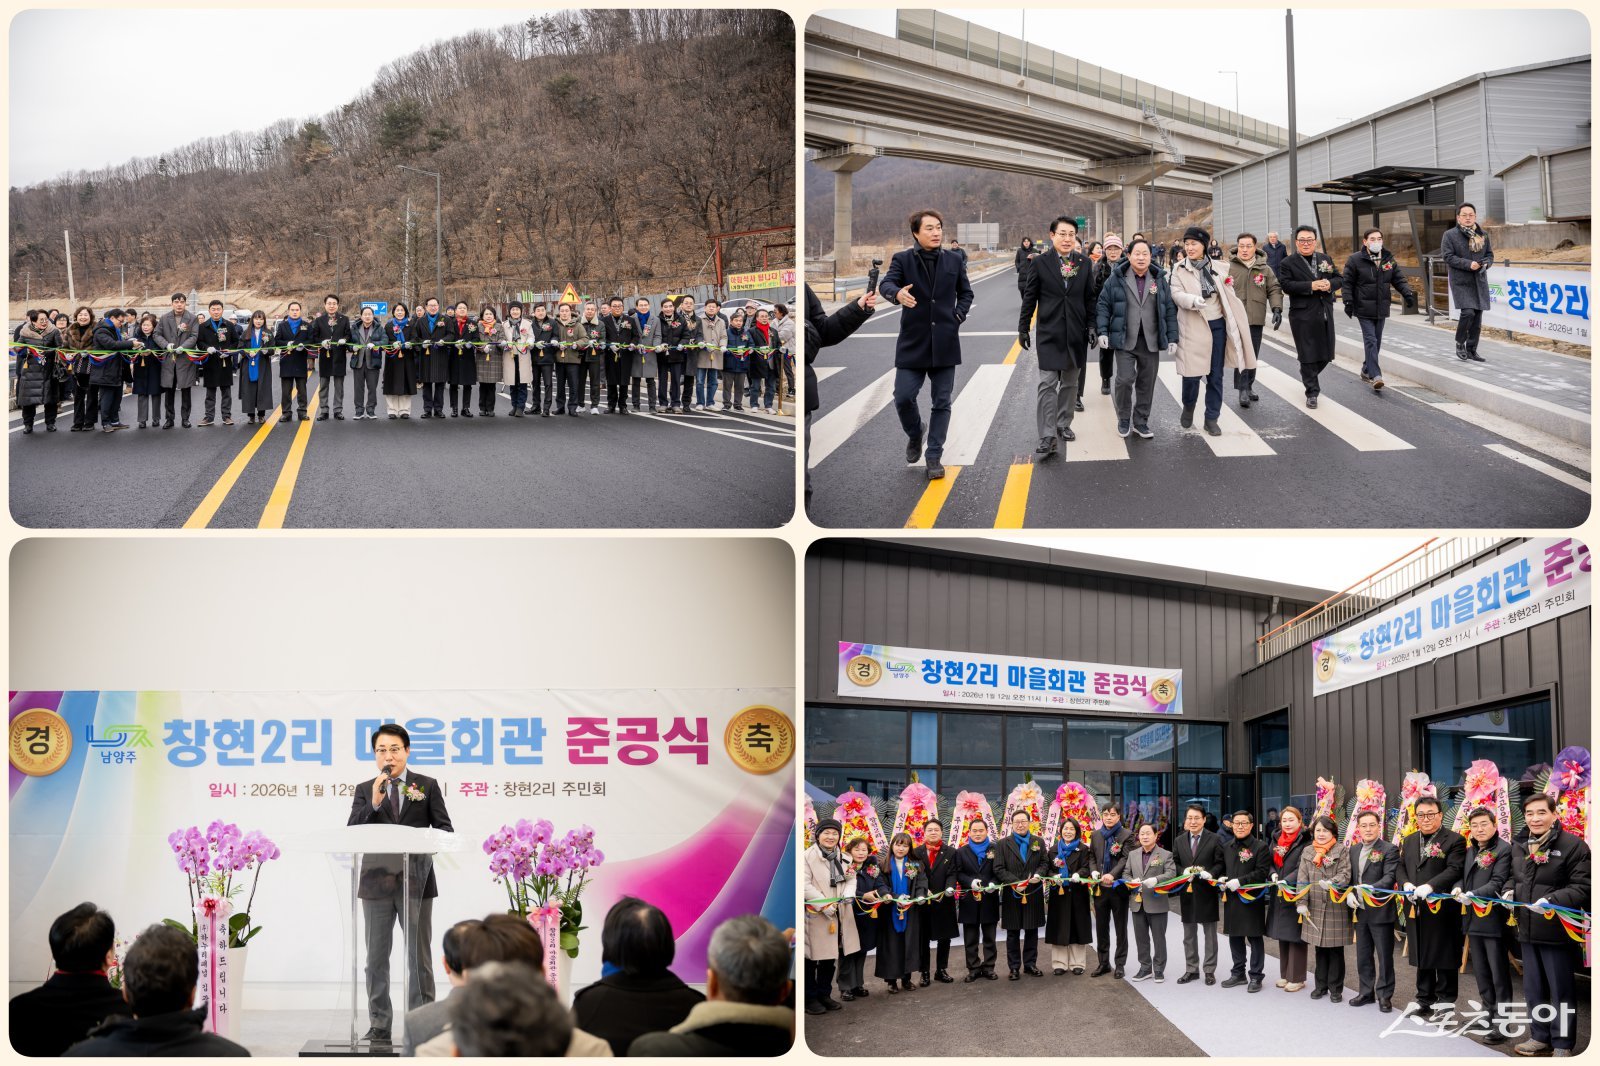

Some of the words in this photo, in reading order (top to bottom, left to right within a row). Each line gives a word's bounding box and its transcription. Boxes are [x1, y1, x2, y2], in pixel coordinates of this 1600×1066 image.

[1507, 279, 1589, 320] 창현2리
[1528, 319, 1542, 329] 일시
[1548, 323, 1573, 334] 2026년
[1577, 328, 1588, 337] 1월
[1360, 607, 1423, 660] 창현2리
[1431, 558, 1531, 629] 마을회관
[1484, 619, 1500, 632] 주관
[1508, 603, 1541, 624] 창현2리
[1545, 589, 1575, 610] 주민회
[1438, 637, 1452, 648] 오전
[1455, 629, 1471, 643] 11시
[857, 662, 871, 677] 경
[1322, 656, 1329, 672] 경
[921, 659, 998, 687] 창현2리
[1008, 665, 1086, 693] 마을회관
[1094, 672, 1147, 697] 준공식
[1158, 684, 1168, 696] 축
[25, 725, 51, 755] 경
[162, 718, 333, 768] 창현2리
[566, 717, 708, 766] 준공식
[745, 723, 773, 752] 축
[101, 751, 136, 764] 남양주
[209, 783, 236, 797] 일시
[250, 783, 297, 797] 2026년
[305, 783, 324, 797] 1월
[459, 782, 489, 797] 주관
[503, 782, 555, 797] 창현2리
[562, 782, 606, 797] 주민회
[219, 923, 227, 1014] 축하드립니다
